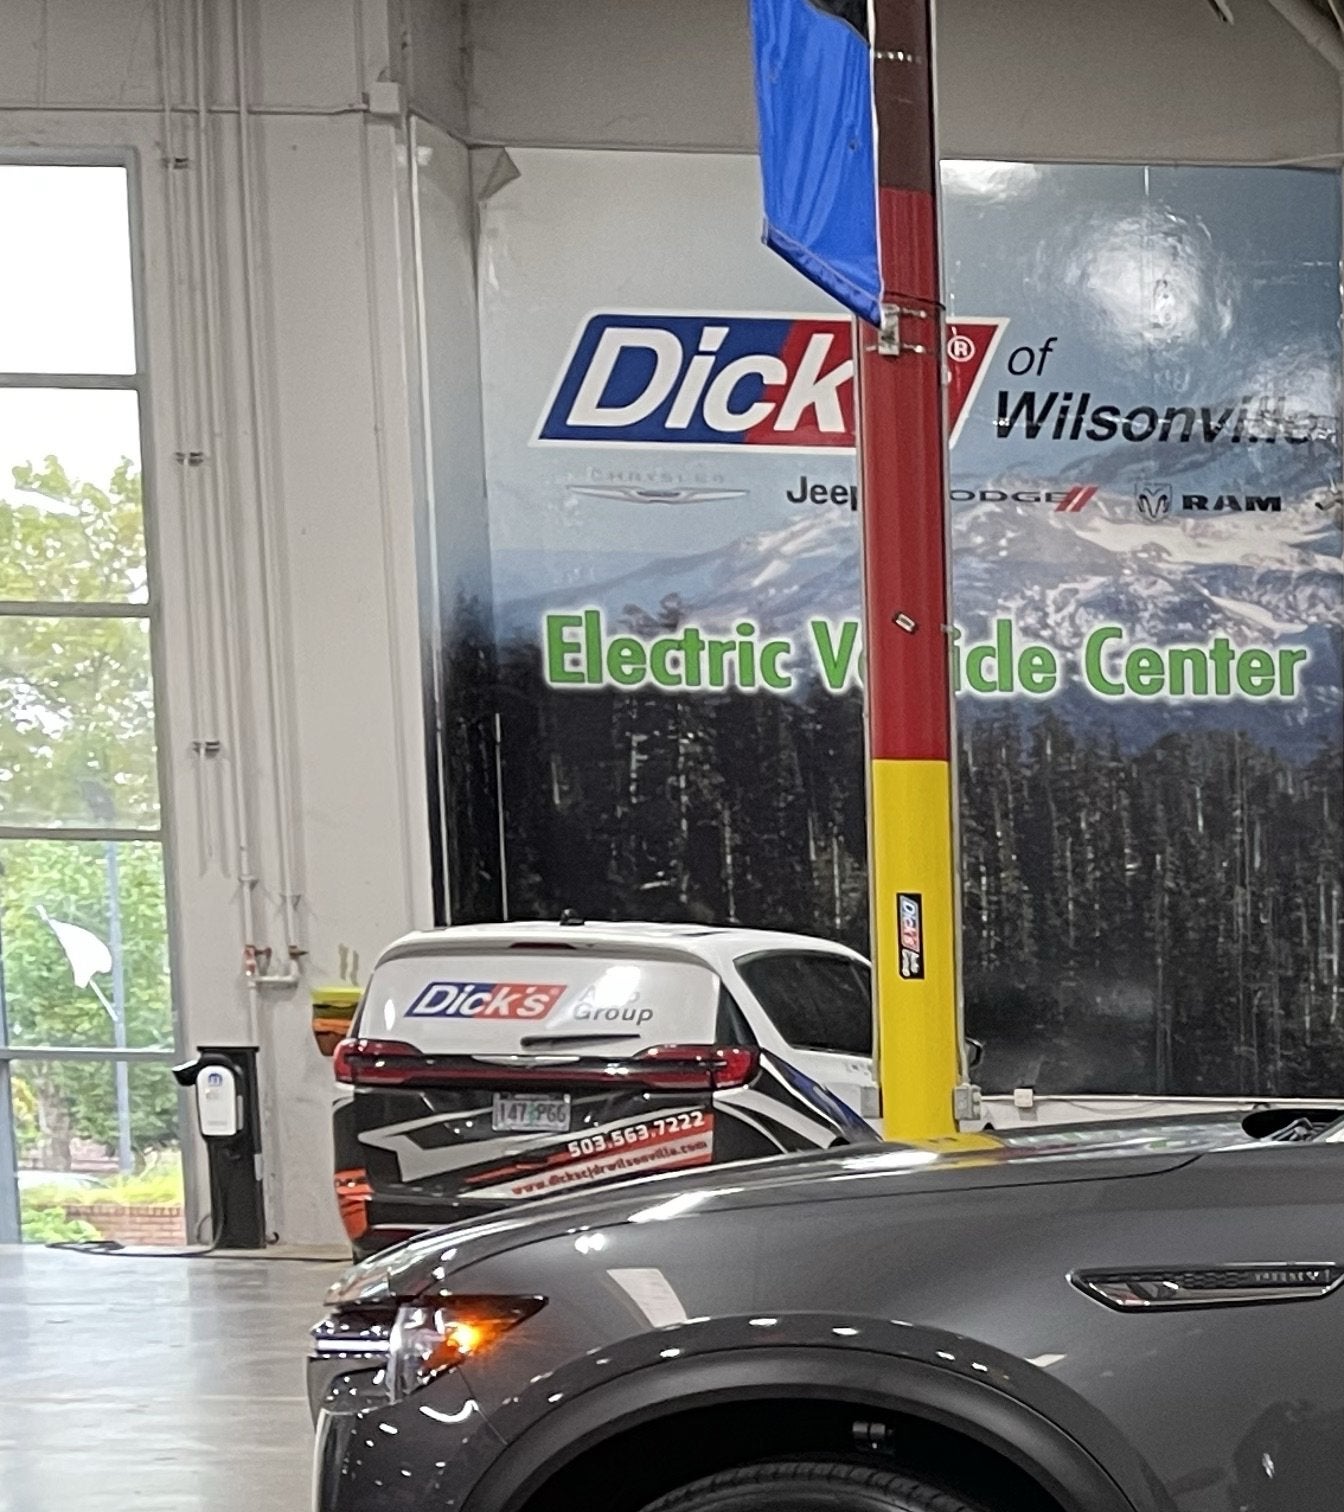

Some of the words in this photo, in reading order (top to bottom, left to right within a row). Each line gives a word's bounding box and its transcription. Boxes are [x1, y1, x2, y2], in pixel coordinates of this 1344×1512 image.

[1007, 337, 1058, 377] of
[565, 326, 853, 433] Dick
[949, 489, 1064, 504] ODGE
[1181, 494, 1282, 512] RAM
[546, 611, 793, 688] Electric
[811, 618, 1058, 694] Vicle
[1084, 625, 1308, 696] Center
[412, 984, 551, 1017] Dick's
[578, 984, 641, 1004] Ao
[574, 1003, 655, 1026] Group
[567, 1111, 706, 1158] 503.563.7222
